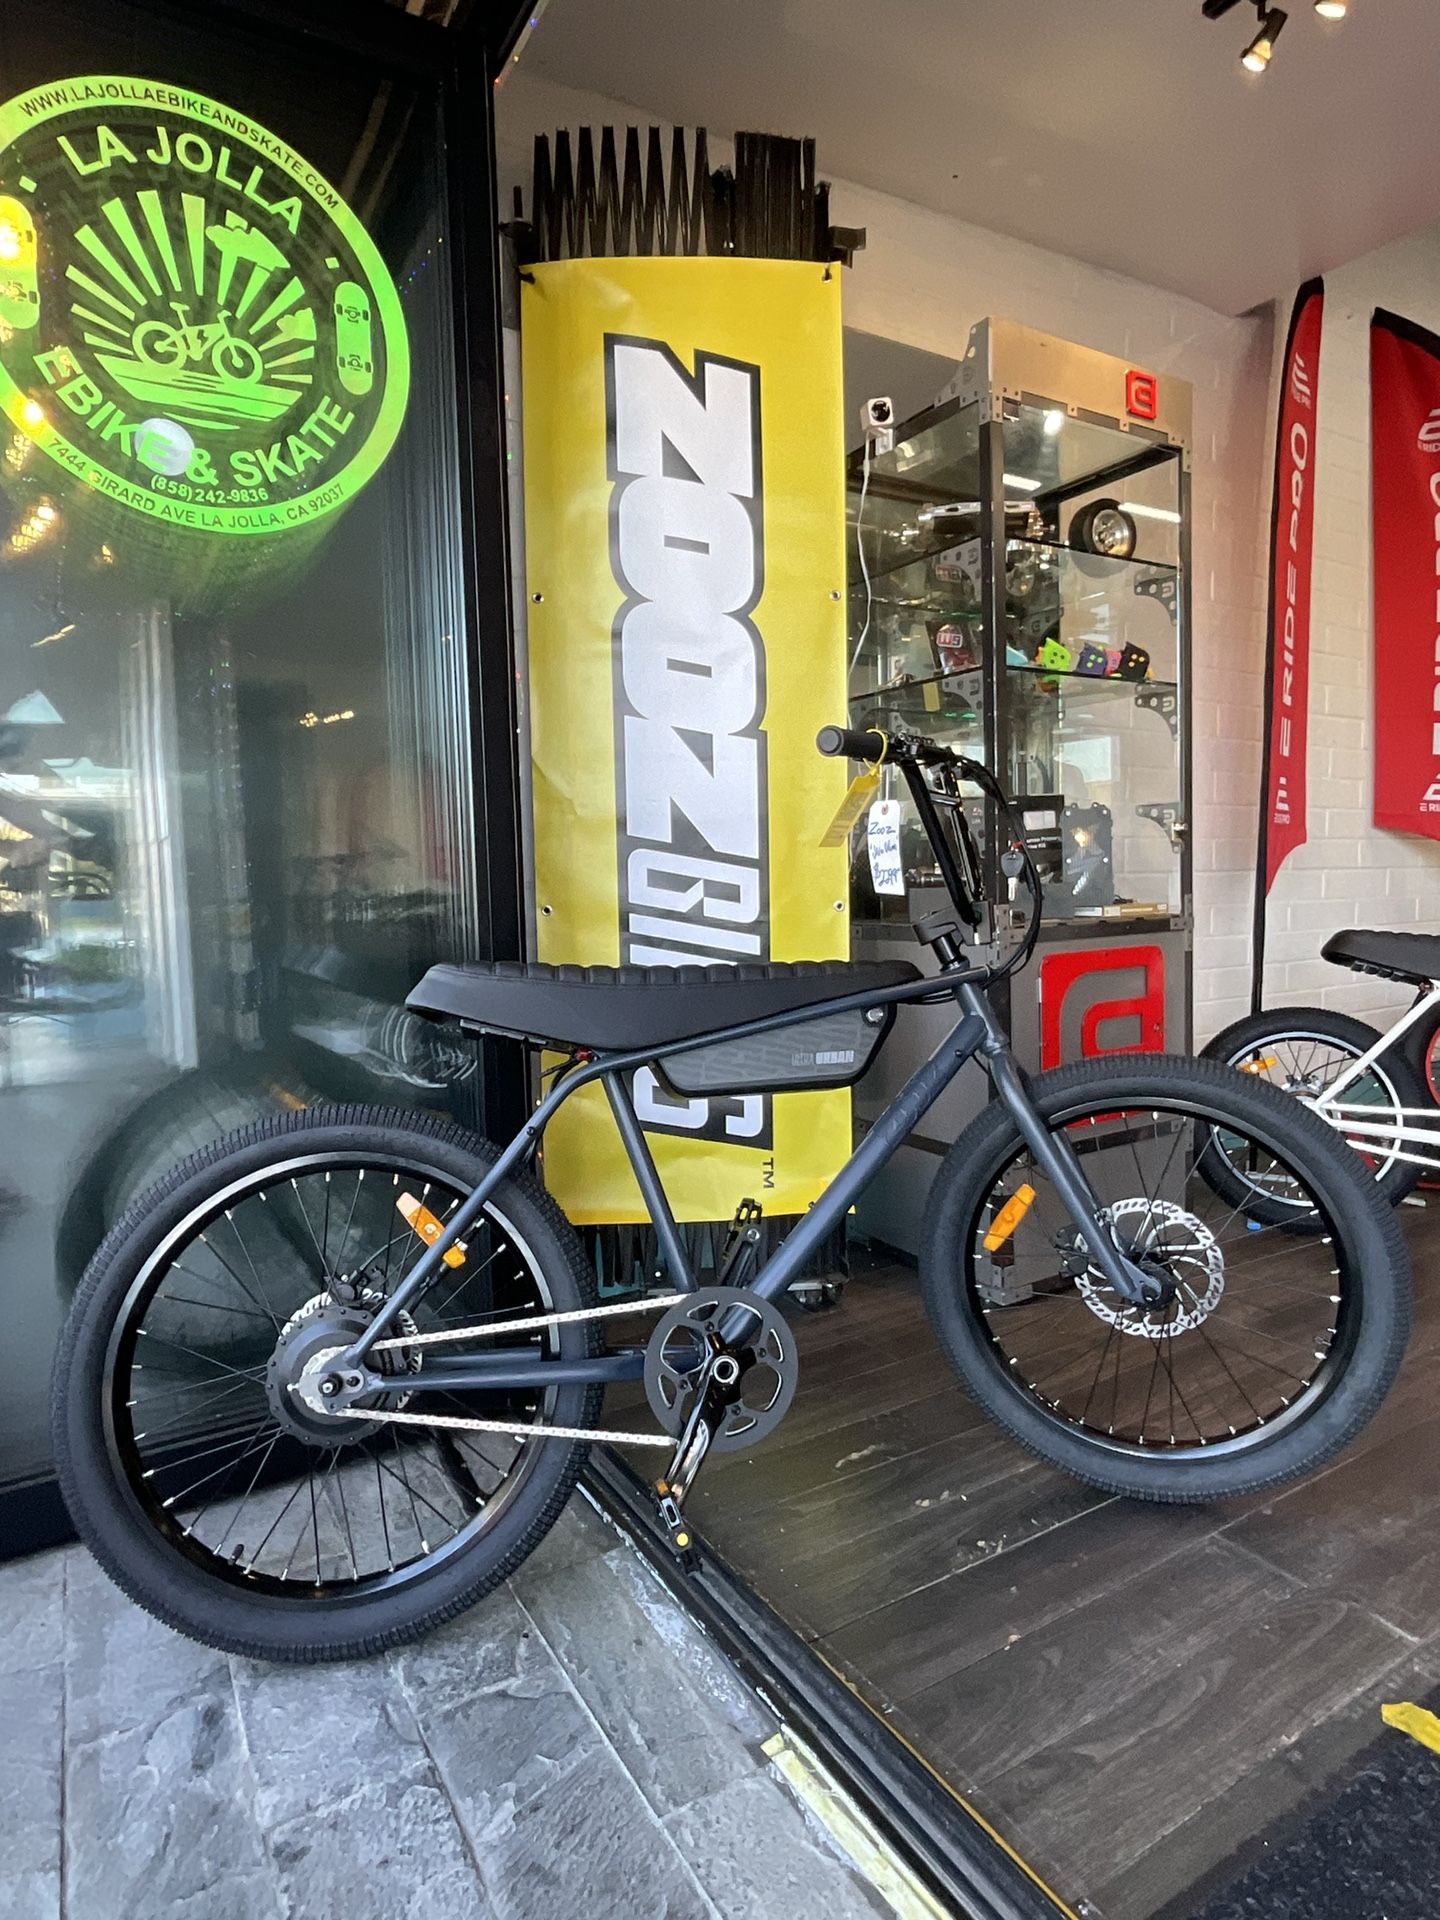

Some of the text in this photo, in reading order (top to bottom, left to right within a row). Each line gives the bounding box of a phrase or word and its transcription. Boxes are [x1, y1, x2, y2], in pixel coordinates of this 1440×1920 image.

[18, 83, 339, 209] WWW.LAJOLLAEBIKEANDSKATE.COM
[56, 125, 302, 235] LA JOLLA
[33, 345, 355, 487] EBIKE & SKATE
[48, 438, 86, 472] 7444
[88, 468, 157, 511] GIRARD
[160, 504, 196, 524] AVE
[201, 514, 223, 528] LA
[286, 507, 310, 521] CA
[308, 483, 345, 513] 92037
